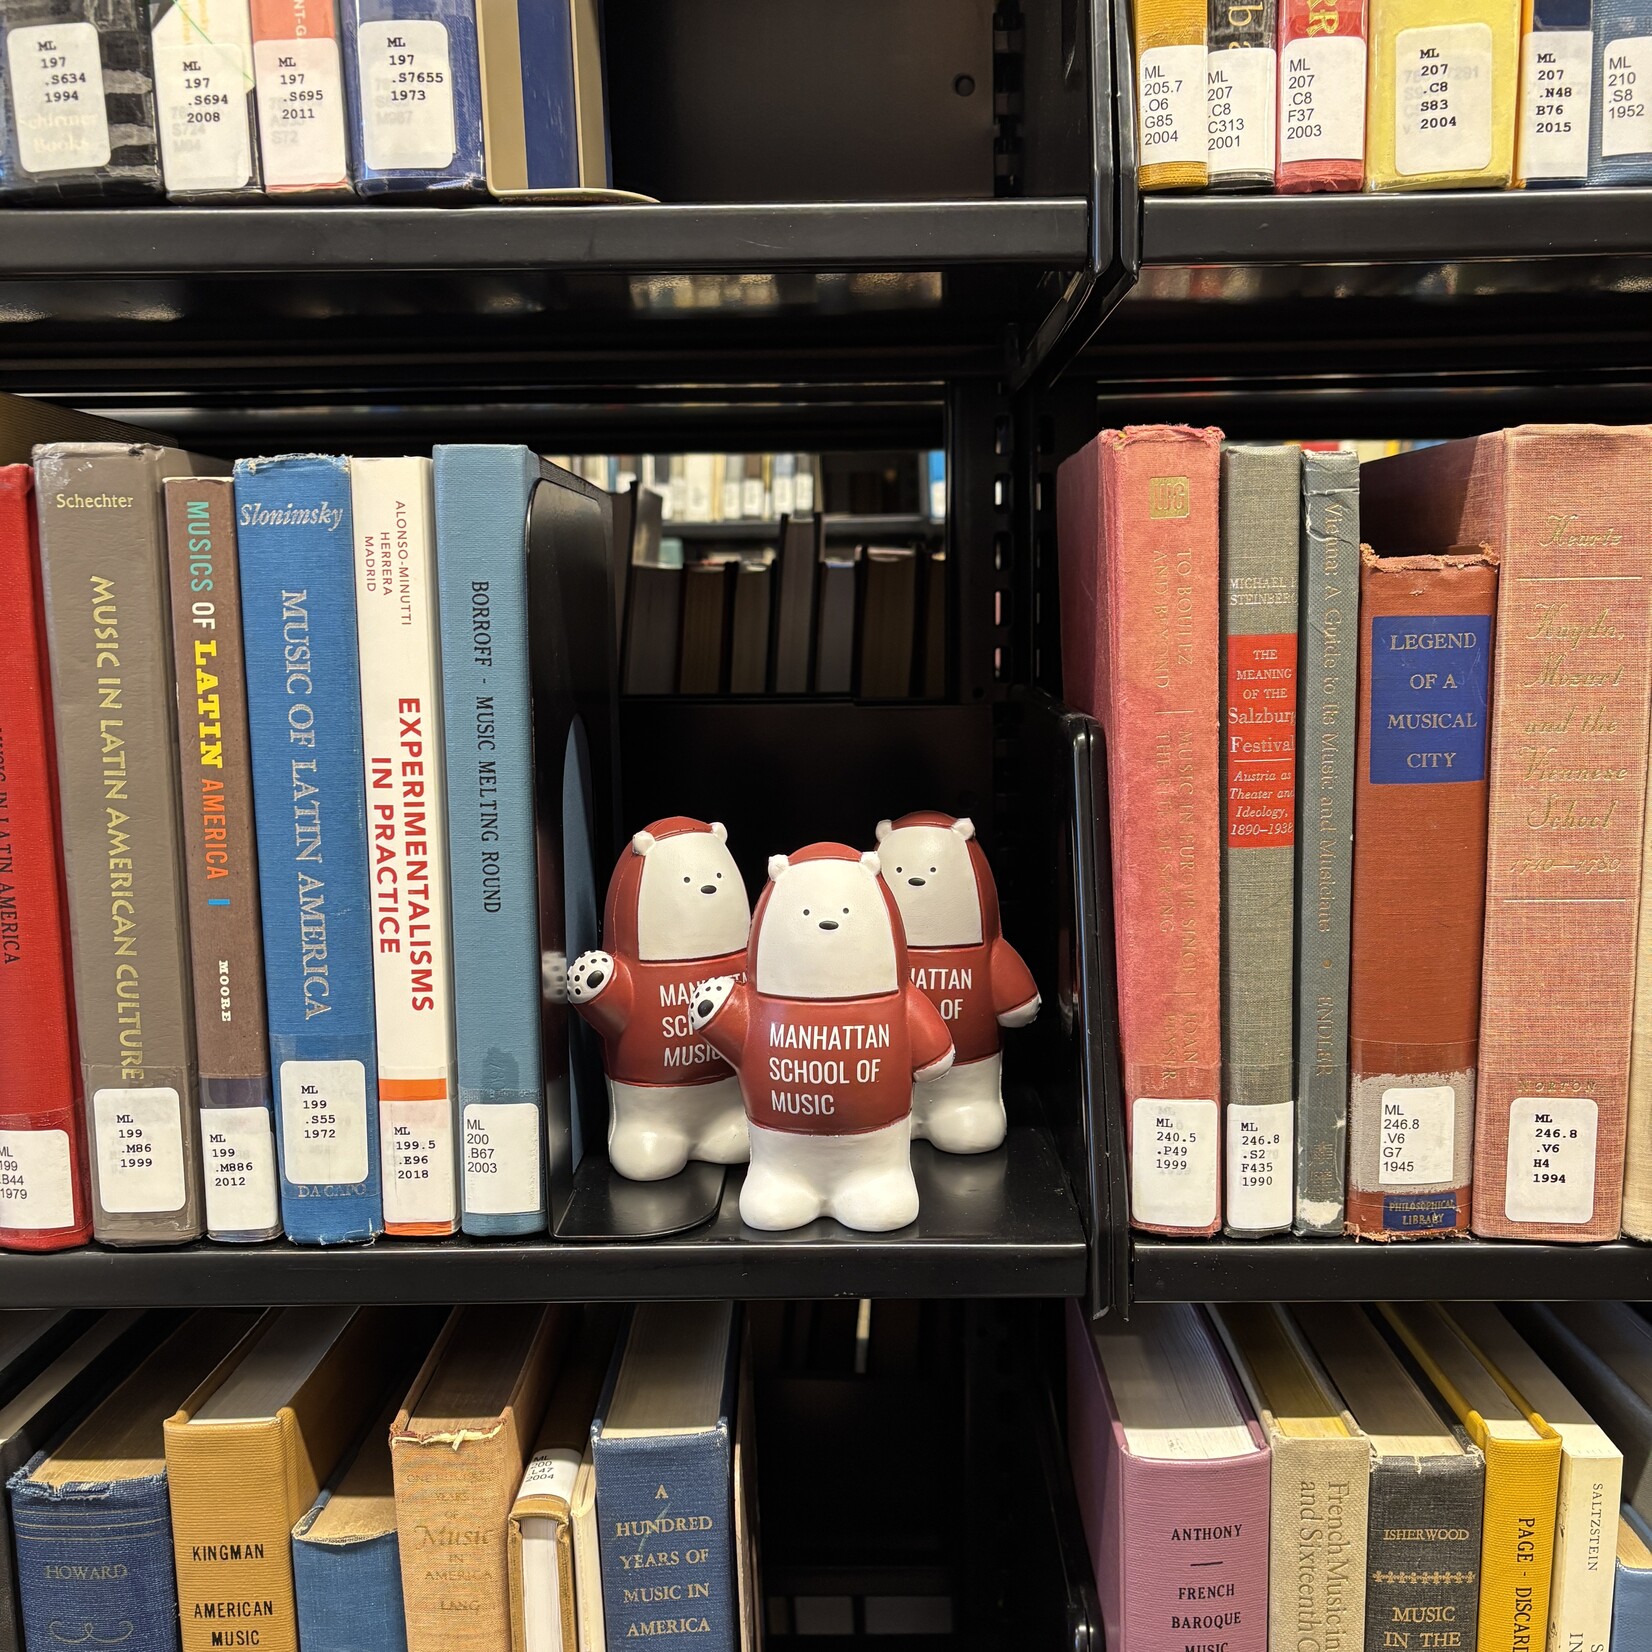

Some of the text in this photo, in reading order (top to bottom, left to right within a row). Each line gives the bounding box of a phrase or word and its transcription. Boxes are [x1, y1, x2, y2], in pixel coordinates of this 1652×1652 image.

[38, 41, 56, 51] ML
[387, 38, 405, 47] ML
[1420, 48, 1439, 59] ML
[1537, 54, 1556, 63] ML
[42, 57, 66, 68] 197
[278, 57, 296, 67] ML
[390, 54, 414, 65] 197
[1290, 58, 1310, 72] ML
[1610, 56, 1631, 70] ML
[183, 61, 201, 71] ML
[1421, 64, 1448, 76] 207
[392, 72, 443, 83] .S7655
[1145, 66, 1165, 79] ML
[1208, 70, 1228, 85] ML
[1538, 70, 1564, 80] 207
[46, 73, 86, 86] .S634
[186, 78, 210, 88] 197
[281, 74, 304, 84] 197
[1289, 75, 1314, 89] 207
[1608, 72, 1636, 86] 210
[1144, 80, 1182, 96] 205.7
[1208, 86, 1232, 101] 207
[1424, 82, 1448, 94] .C8
[1540, 87, 1572, 98] .N48
[45, 91, 78, 102] 1994
[188, 94, 228, 105] .S694
[284, 90, 323, 102] .S695
[392, 90, 426, 101] 1973
[1289, 92, 1312, 106] .C8
[1609, 89, 1632, 103] .S8
[1208, 103, 1231, 118] .C8
[1421, 100, 1448, 111] S83
[1536, 105, 1563, 115] B76
[282, 108, 314, 119] 2011
[1288, 108, 1314, 122] F37
[1609, 104, 1644, 119] 1952
[187, 112, 220, 123] 2008
[1145, 114, 1173, 128] G85
[1421, 116, 1456, 129] 2004
[1208, 118, 1244, 134] C313
[1287, 124, 1322, 139] 2003
[1536, 122, 1571, 132] 2015
[1145, 130, 1178, 145] 2004
[1208, 135, 1239, 150] 2001
[56, 494, 133, 508] Schechter
[240, 502, 343, 531] Slonimsky
[365, 537, 376, 592] MADRID
[381, 532, 392, 595] HERRERA
[396, 501, 411, 625] ALONSO-MINUTTI
[1391, 633, 1476, 650] LEGEND
[1253, 650, 1277, 660] THE
[1237, 669, 1291, 680] MEANING
[1410, 674, 1457, 689] OF A
[187, 502, 228, 879] MUSICS OF LATIN AMERICA
[1243, 688, 1287, 699] OF THE
[1388, 713, 1477, 729] MUSICAL
[472, 582, 501, 912] BORROFF MUSIC MELTING ROUND
[1407, 753, 1456, 768] CITY
[1234, 771, 1276, 781] Austria
[1230, 788, 1273, 800] Theater
[282, 590, 331, 1020] MUSIC OF LATIN AMERICA
[1236, 806, 1288, 819] Ideology,
[90, 576, 144, 1079] MUSIC IN LATIN AMERICAN CULTURE
[372, 758, 400, 953] IN PRACTICE
[399, 698, 434, 1011] EXPERIMENTALISMS
[0, 882, 20, 964] AMERICA
[219, 960, 231, 1021] MOORE
[941, 999, 963, 1019] OF
[770, 1023, 889, 1050] MANHATTAN
[770, 1058, 880, 1084] SCHOOL OF
[301, 1086, 318, 1094] ML
[304, 1100, 326, 1109] 199
[771, 1090, 834, 1115] MUSIC
[1385, 1104, 1404, 1115] ML
[116, 1115, 133, 1123] ML
[306, 1115, 335, 1124] .S55
[1156, 1118, 1173, 1128] ML
[1535, 1114, 1552, 1122] ML
[467, 1119, 485, 1130] ML
[1241, 1122, 1258, 1131] ML
[1384, 1119, 1419, 1129] 246.8
[119, 1129, 142, 1138] 199
[305, 1129, 335, 1138] 1972
[394, 1127, 410, 1135] ML
[1536, 1128, 1577, 1138] 246.8
[210, 1134, 226, 1142] ML
[467, 1133, 489, 1144] 200
[1157, 1132, 1196, 1142] 240.5
[1242, 1134, 1279, 1145] 246.8
[1384, 1133, 1404, 1144] .V6
[122, 1144, 151, 1153] .M86
[396, 1140, 435, 1150] 199.5
[1537, 1144, 1559, 1153] .V6
[212, 1148, 235, 1157] 199
[468, 1148, 494, 1159] .B67
[1158, 1146, 1187, 1156] .P49
[1244, 1150, 1265, 1159] .S2
[1383, 1147, 1402, 1157] G7
[121, 1158, 152, 1167] 1999
[400, 1156, 428, 1164] .E96
[1157, 1159, 1186, 1170] 1999
[1534, 1159, 1549, 1167] H4
[216, 1162, 252, 1172] .M886
[468, 1162, 497, 1173] 2003
[1242, 1162, 1272, 1172] F435
[1384, 1162, 1414, 1172] 1945
[398, 1170, 428, 1179] 2018
[1534, 1174, 1565, 1183] 1994
[216, 1177, 245, 1186] 2012
[1243, 1176, 1272, 1186] 1990
[298, 1184, 366, 1197] DA CAPO
[1403, 1213, 1444, 1226] LIBRARY
[655, 1485, 668, 1499] A
[616, 1516, 712, 1537] HUNDRED
[1172, 1524, 1242, 1540] ANTHONY
[1588, 1484, 1603, 1571] SALTZSTEIN
[1383, 1529, 1469, 1540] ISHERWOOD
[1517, 1518, 1535, 1562] PAGE
[193, 1544, 264, 1561] KINGMAN
[620, 1550, 708, 1569] YEARS OF
[624, 1583, 709, 1603] MUSIC IN
[1179, 1584, 1234, 1600] FRENCH
[195, 1601, 273, 1618] AMERICAN
[1392, 1606, 1455, 1622] MUSIC
[1172, 1612, 1241, 1629] BAROQUE
[627, 1619, 710, 1637] AMERICA
[212, 1630, 259, 1646] MUSIC
[1384, 1632, 1461, 1648] IN THE
